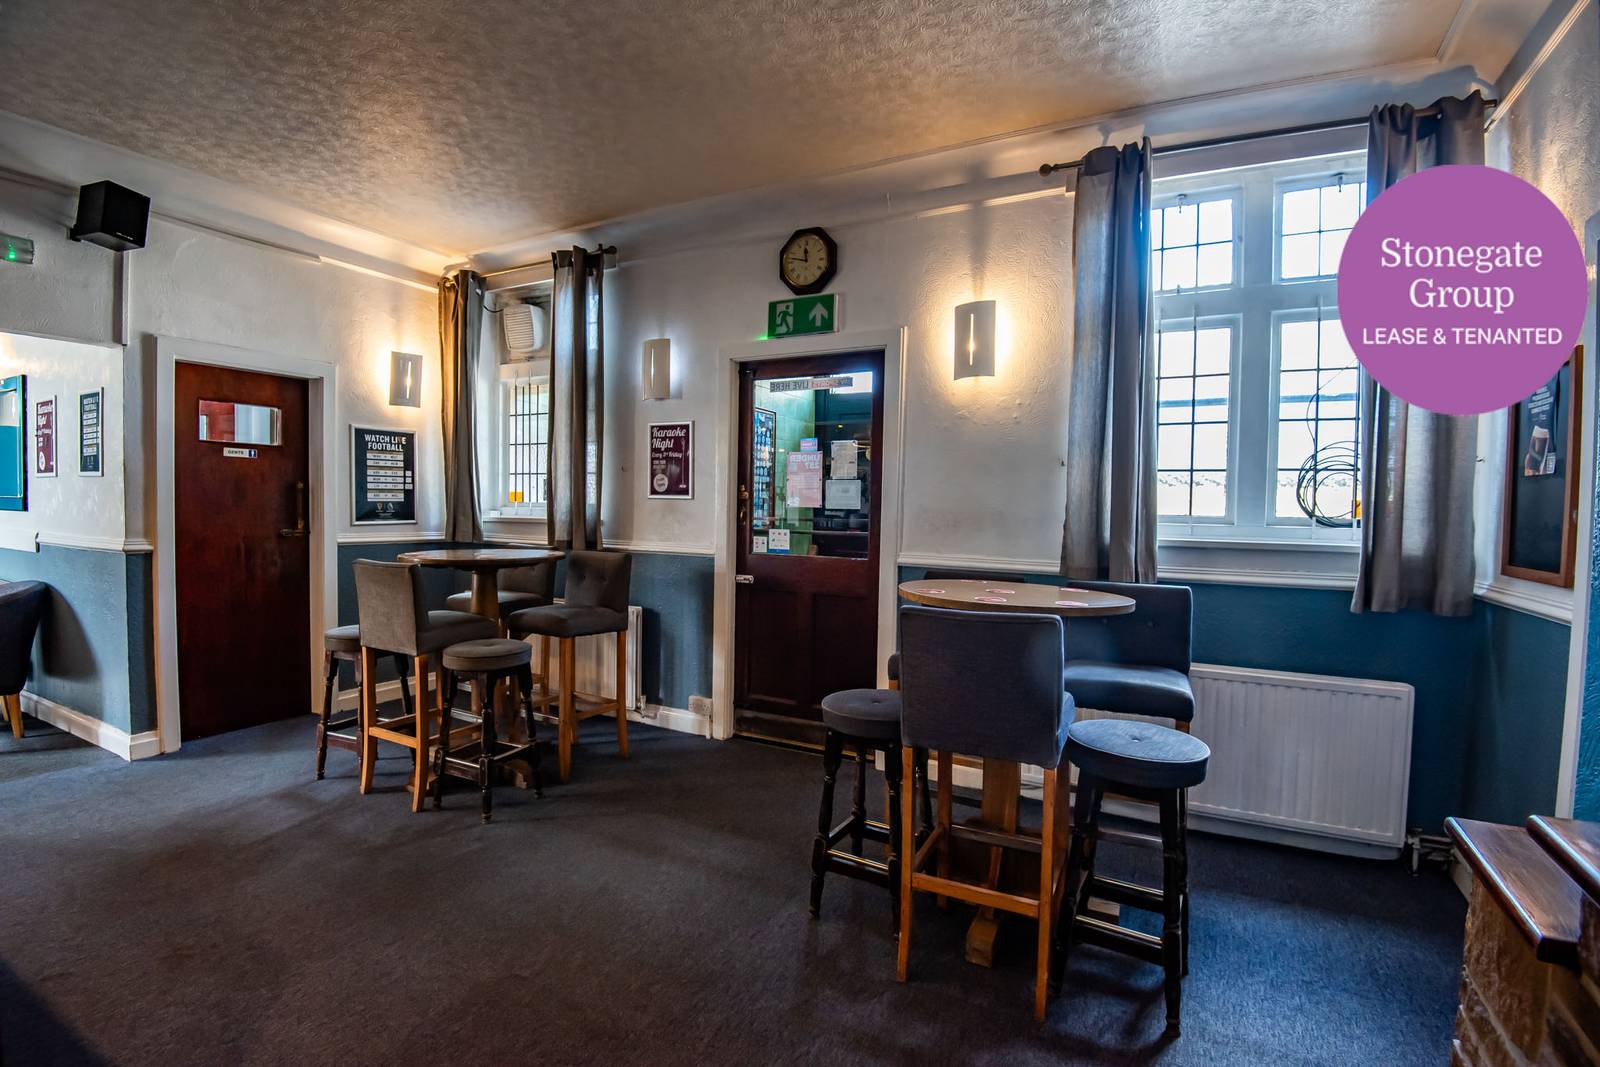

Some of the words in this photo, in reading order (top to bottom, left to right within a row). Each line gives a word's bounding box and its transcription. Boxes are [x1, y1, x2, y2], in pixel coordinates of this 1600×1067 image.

[652, 427, 687, 437] Karaoke
[364, 433, 390, 443] WATCH
[367, 442, 404, 452] FOOTBALL
[652, 438, 674, 451] Night
